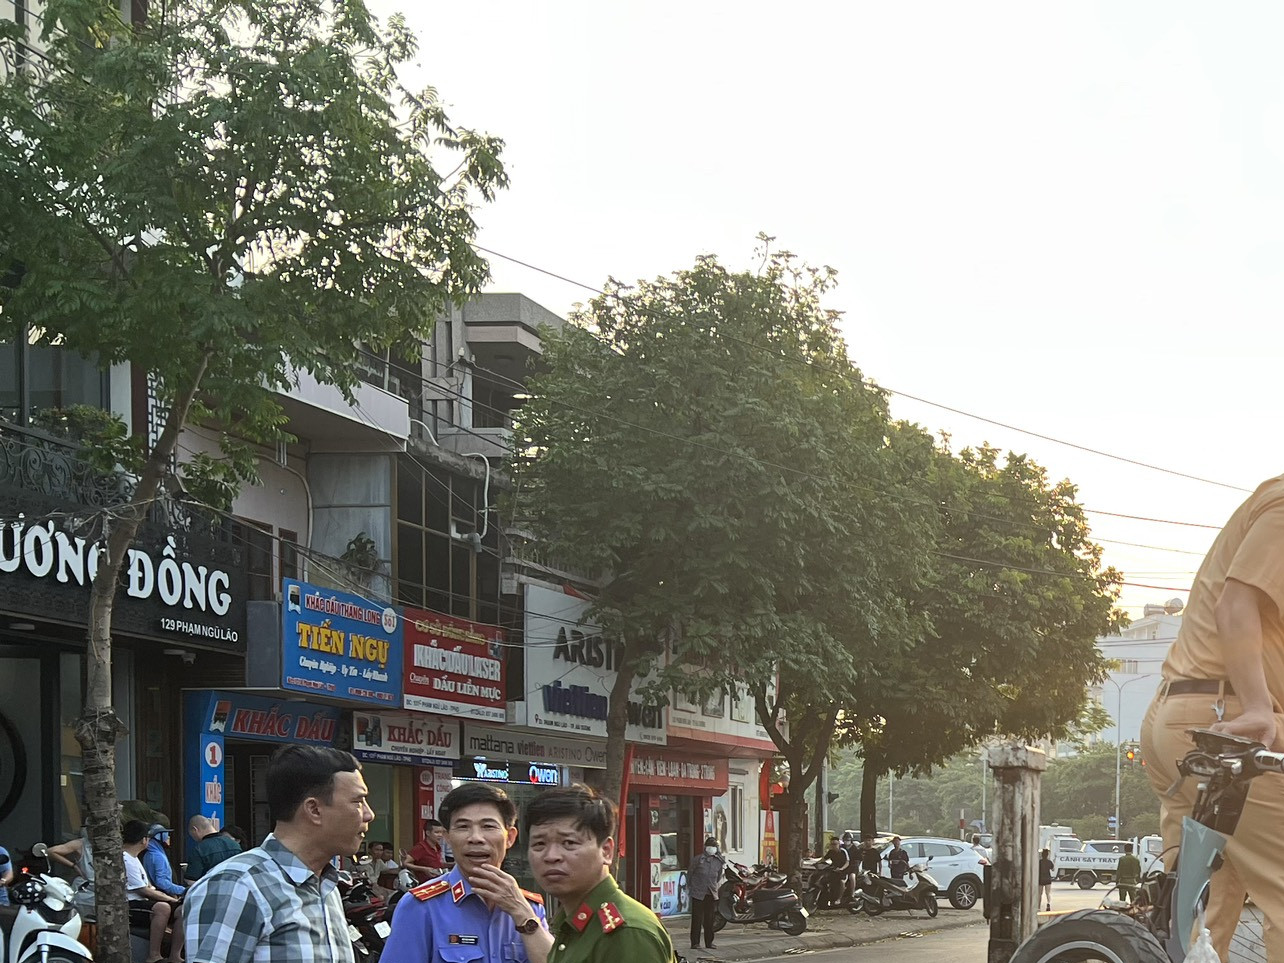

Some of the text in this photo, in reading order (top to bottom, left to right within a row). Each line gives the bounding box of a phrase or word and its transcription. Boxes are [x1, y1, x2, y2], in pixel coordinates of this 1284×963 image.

[127, 535, 232, 616] ĐỒNG
[160, 617, 238, 642] 129 PHẠM NGŨ LÃO
[363, 607, 381, 626] LONG
[296, 619, 345, 656] TIẾN
[414, 640, 501, 682] KHẮC DẤU LASER
[433, 675, 455, 693] DẤU
[481, 687, 502, 702] MỰC
[230, 704, 336, 742] KHẮC DẤU
[387, 721, 452, 748] KHẮC DẤU
[209, 745, 217, 765] 1
[470, 734, 514, 754] mattana
[549, 746, 582, 761] ARISTINO
[529, 765, 558, 784] Owen
